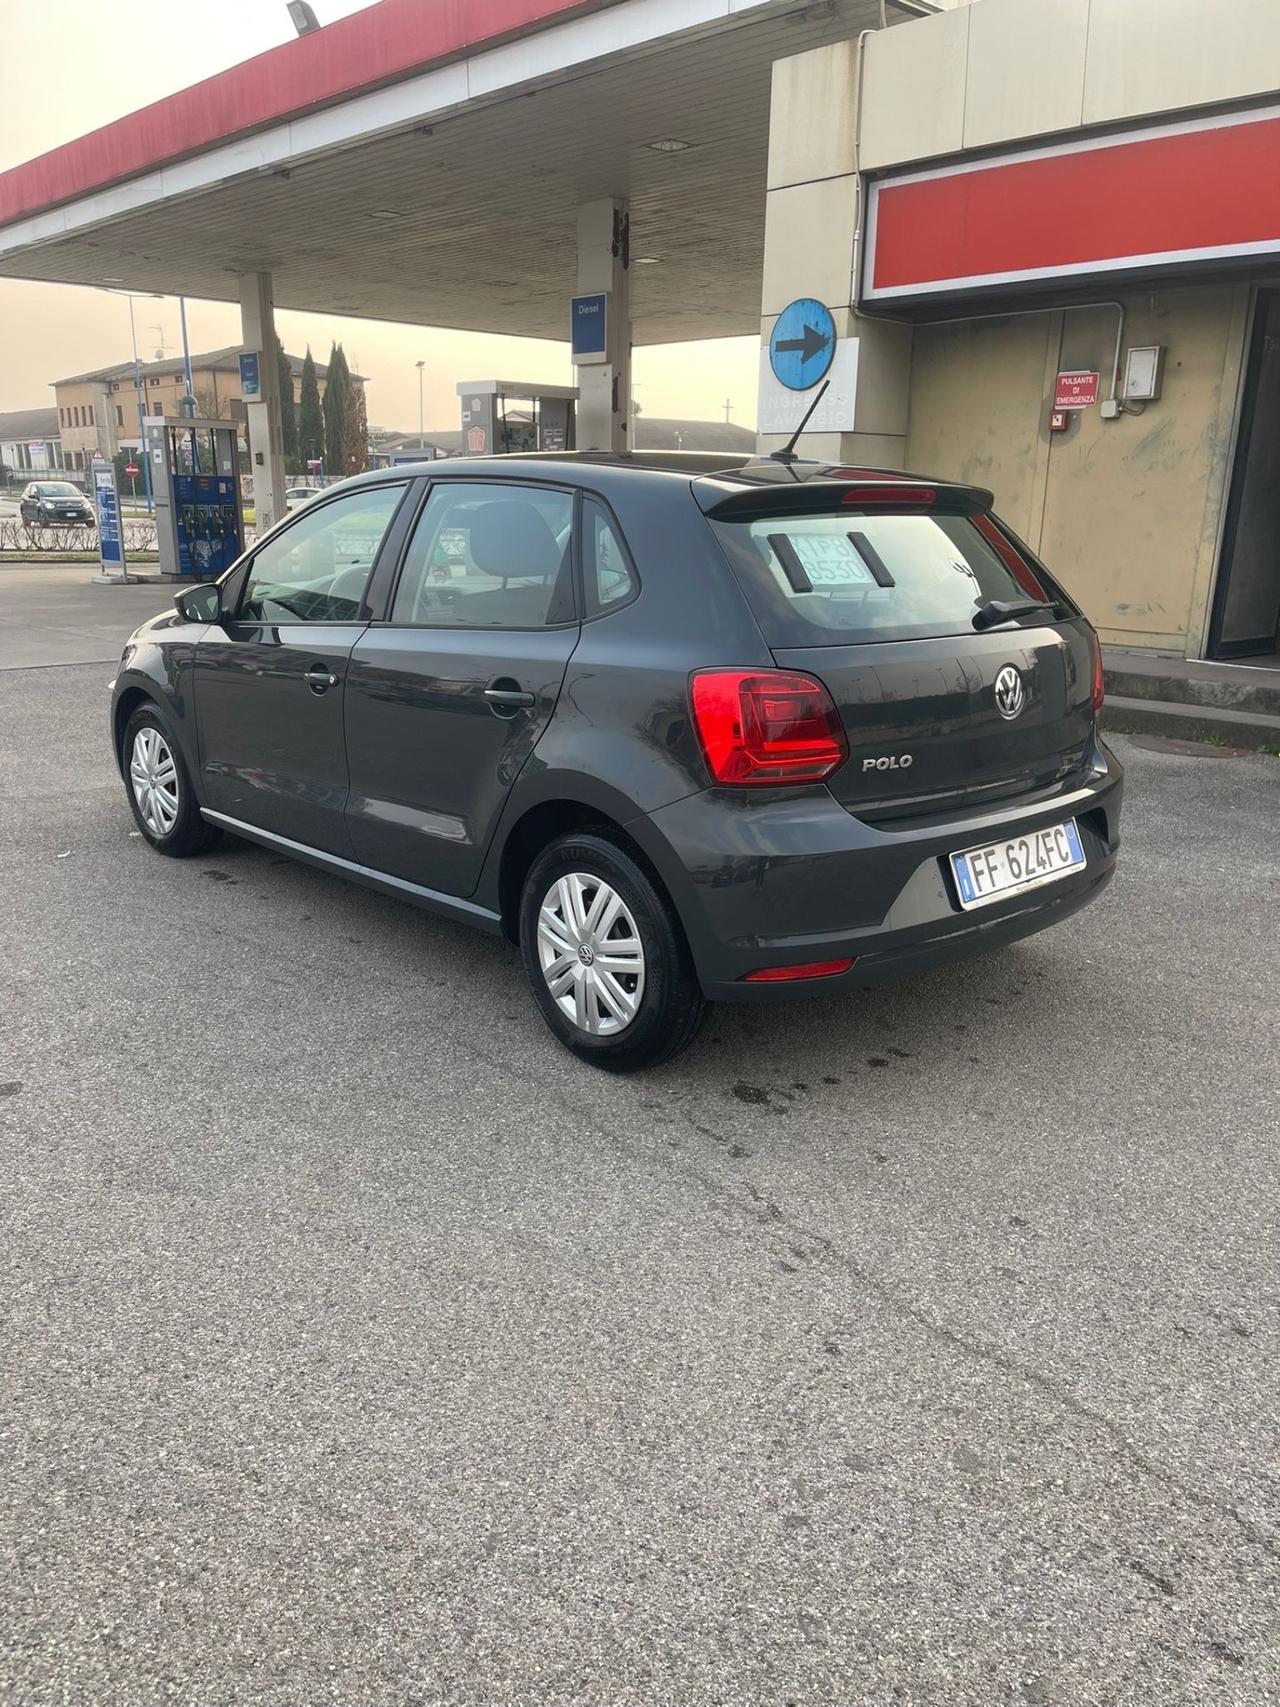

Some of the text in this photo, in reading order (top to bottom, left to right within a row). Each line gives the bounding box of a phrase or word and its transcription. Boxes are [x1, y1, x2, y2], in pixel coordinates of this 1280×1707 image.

[578, 303, 599, 314] Diesel
[1061, 376, 1094, 385] PULSANTE
[1072, 386, 1080, 394] DI
[1056, 396, 1095, 405] EMERGENZA
[803, 560, 865, 580] 8530
[862, 755, 913, 772] POLO
[970, 828, 1069, 892] FF 624FC
